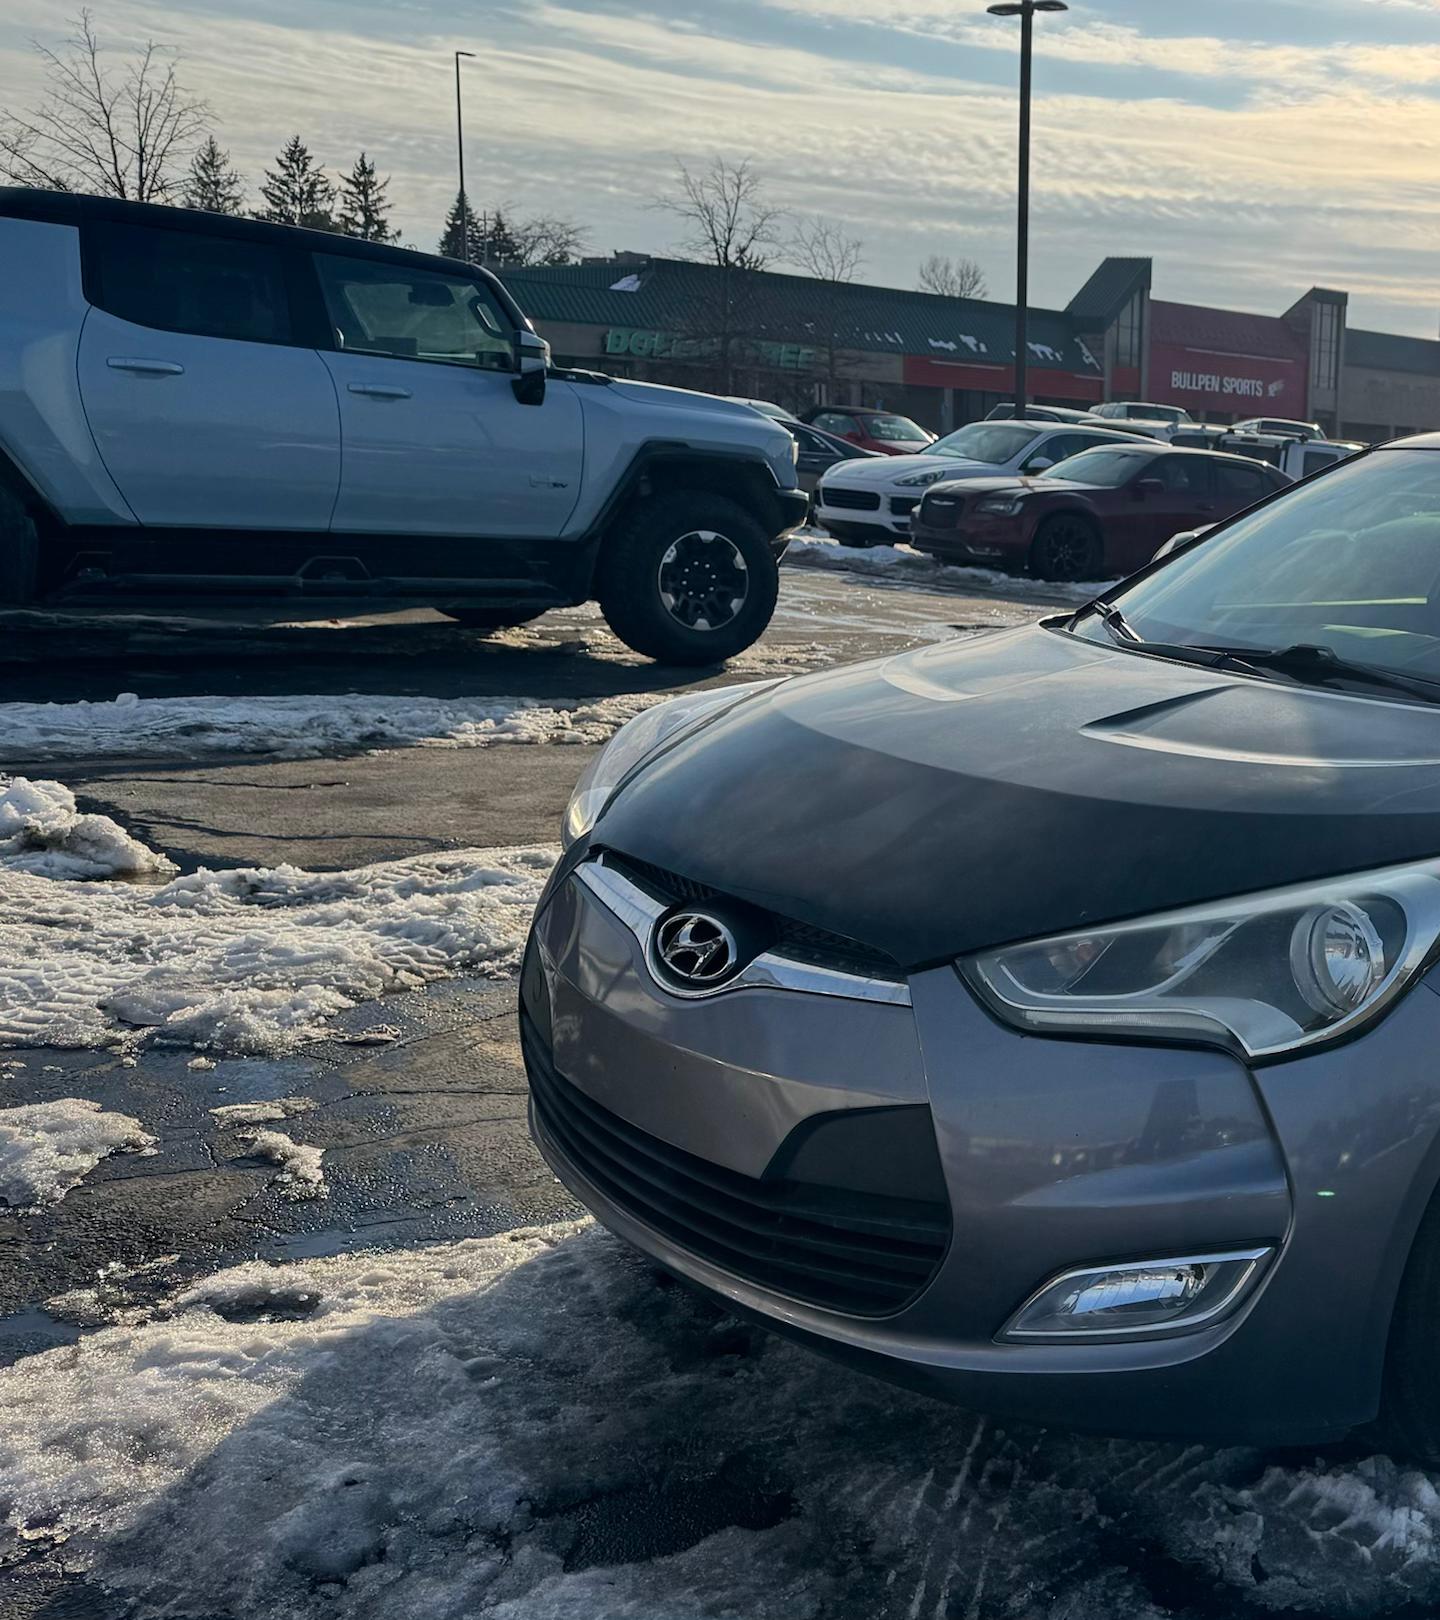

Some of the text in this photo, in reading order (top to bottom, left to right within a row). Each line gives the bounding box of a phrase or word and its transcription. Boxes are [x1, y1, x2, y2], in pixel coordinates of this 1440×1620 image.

[606, 328, 725, 362] DOL
[1171, 370, 1263, 397] BULLPEN SPORTS
